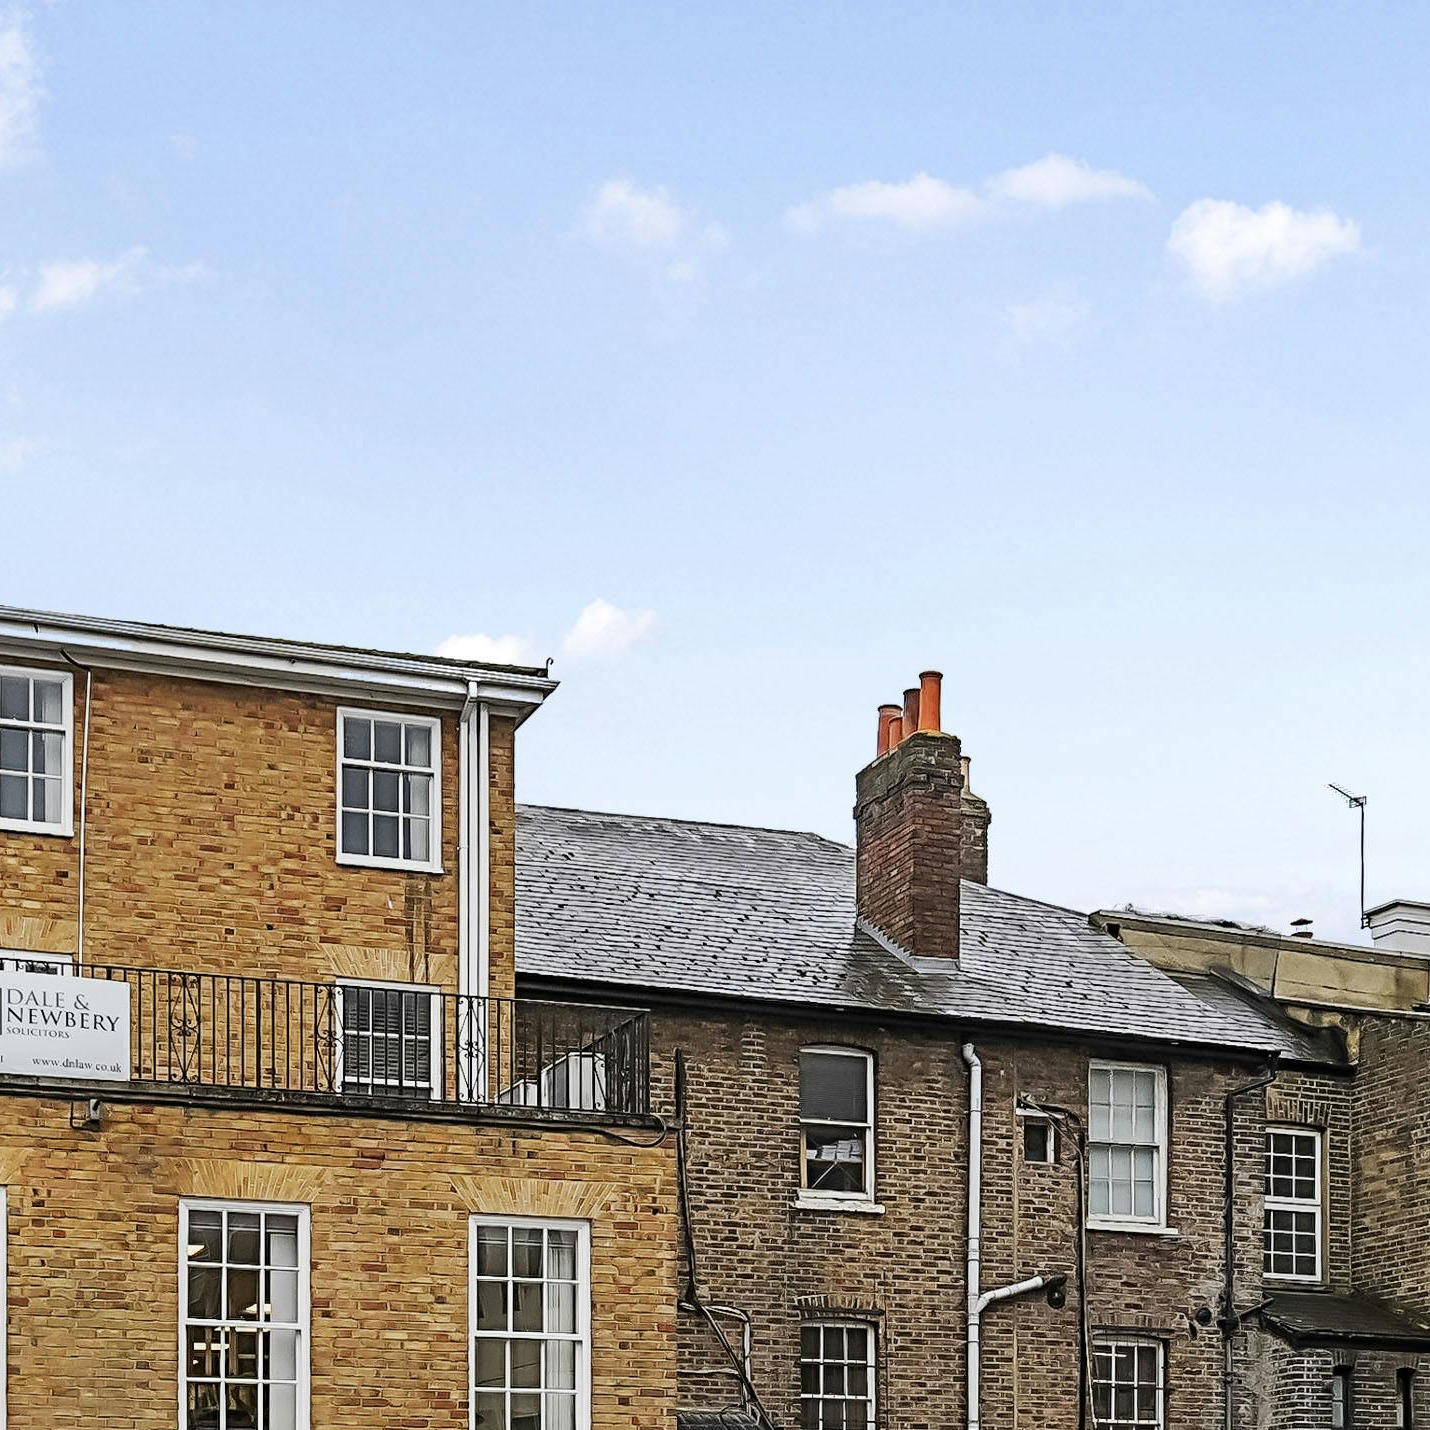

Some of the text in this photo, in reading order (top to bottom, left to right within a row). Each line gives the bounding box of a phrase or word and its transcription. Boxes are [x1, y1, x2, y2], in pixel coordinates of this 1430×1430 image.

[7, 988, 89, 1010] DALE &
[7, 1007, 120, 1032] NEWBERY
[7, 1026, 70, 1039] SOLICITORS
[32, 1057, 122, 1073] www.dnlaw.co.uk
